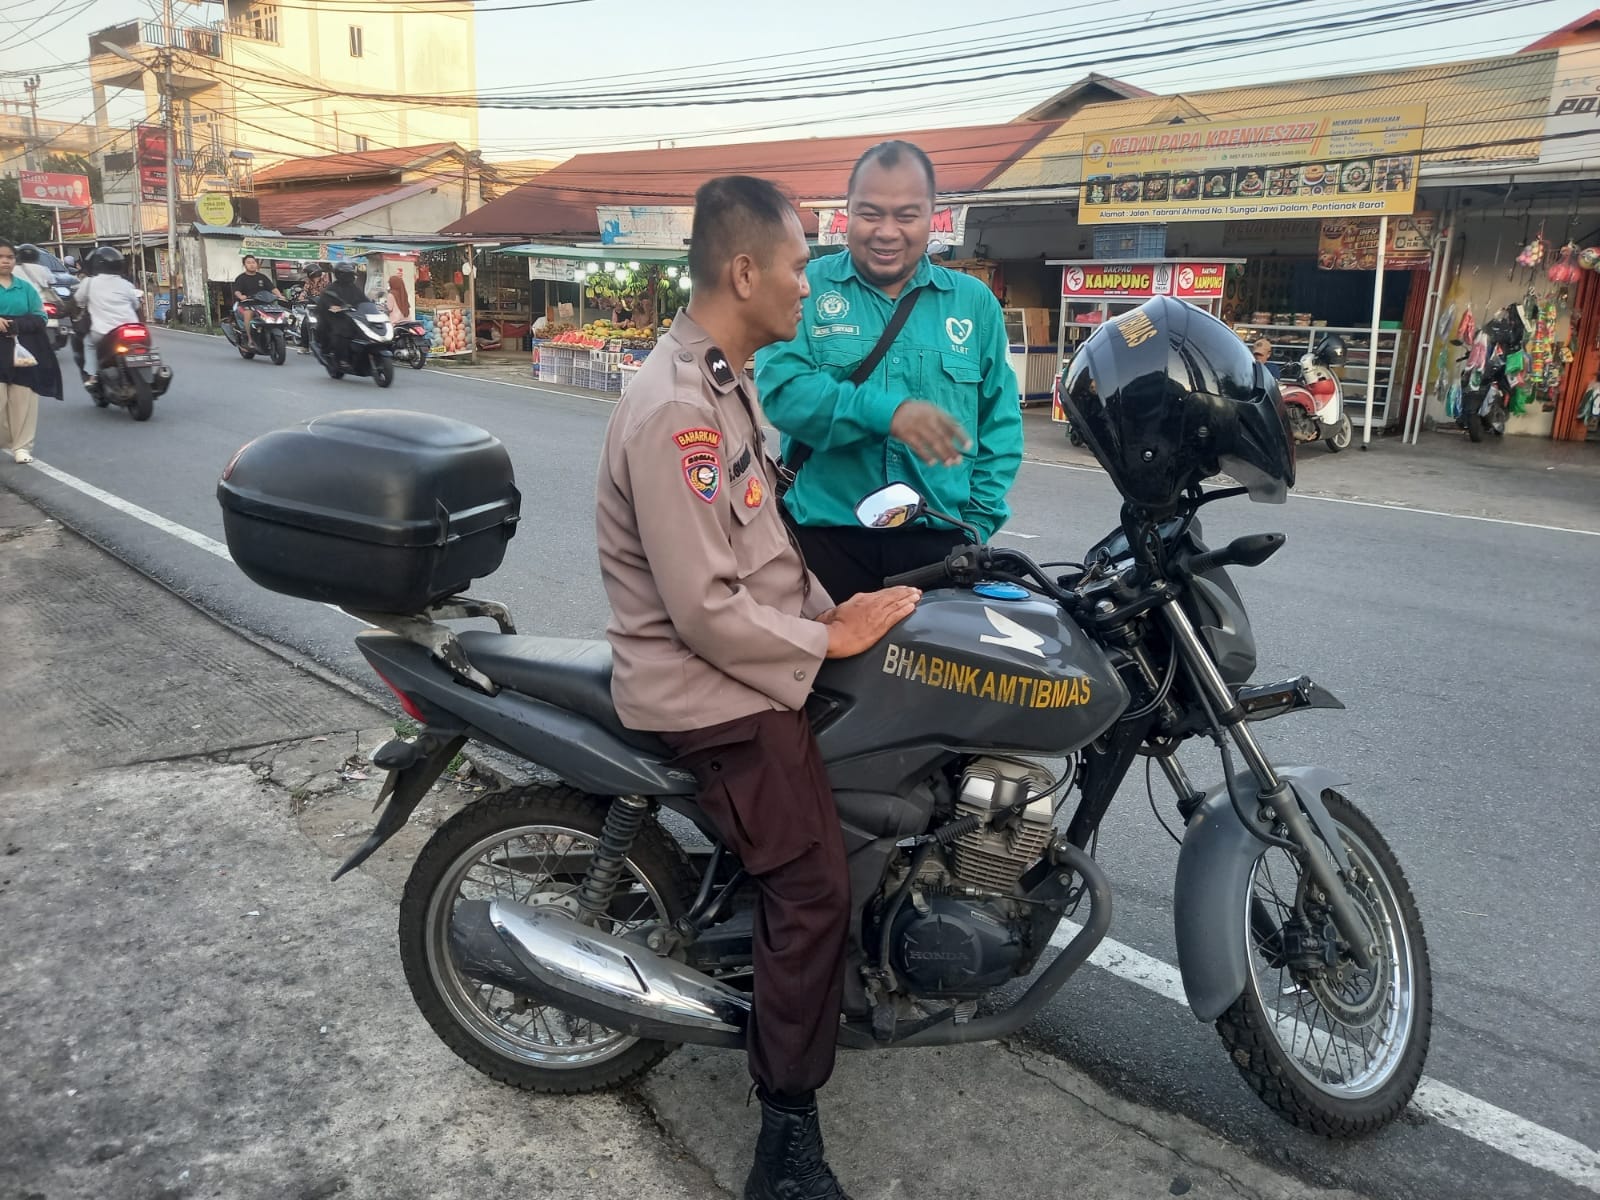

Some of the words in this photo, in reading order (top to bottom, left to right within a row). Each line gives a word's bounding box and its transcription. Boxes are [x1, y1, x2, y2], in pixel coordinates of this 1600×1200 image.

[1108, 135, 1157, 157] KEDAI
[1158, 131, 1202, 153] PAPA
[1203, 122, 1318, 151] KRENYESZZZ
[1152, 208, 1181, 216] Tabrani
[1181, 207, 1210, 215] Ahmad
[1229, 206, 1258, 215] Sungai
[1259, 205, 1279, 213] Jawi
[1311, 201, 1357, 211] Pontianak
[1358, 200, 1385, 209] Barat
[1085, 274, 1150, 289] KAMPUNG
[1194, 276, 1222, 289] KAMPUNG
[678, 430, 719, 446] BAHARKAM
[882, 643, 1092, 708] BHABINKAMTIBMAS
[909, 951, 969, 960] HONDA
